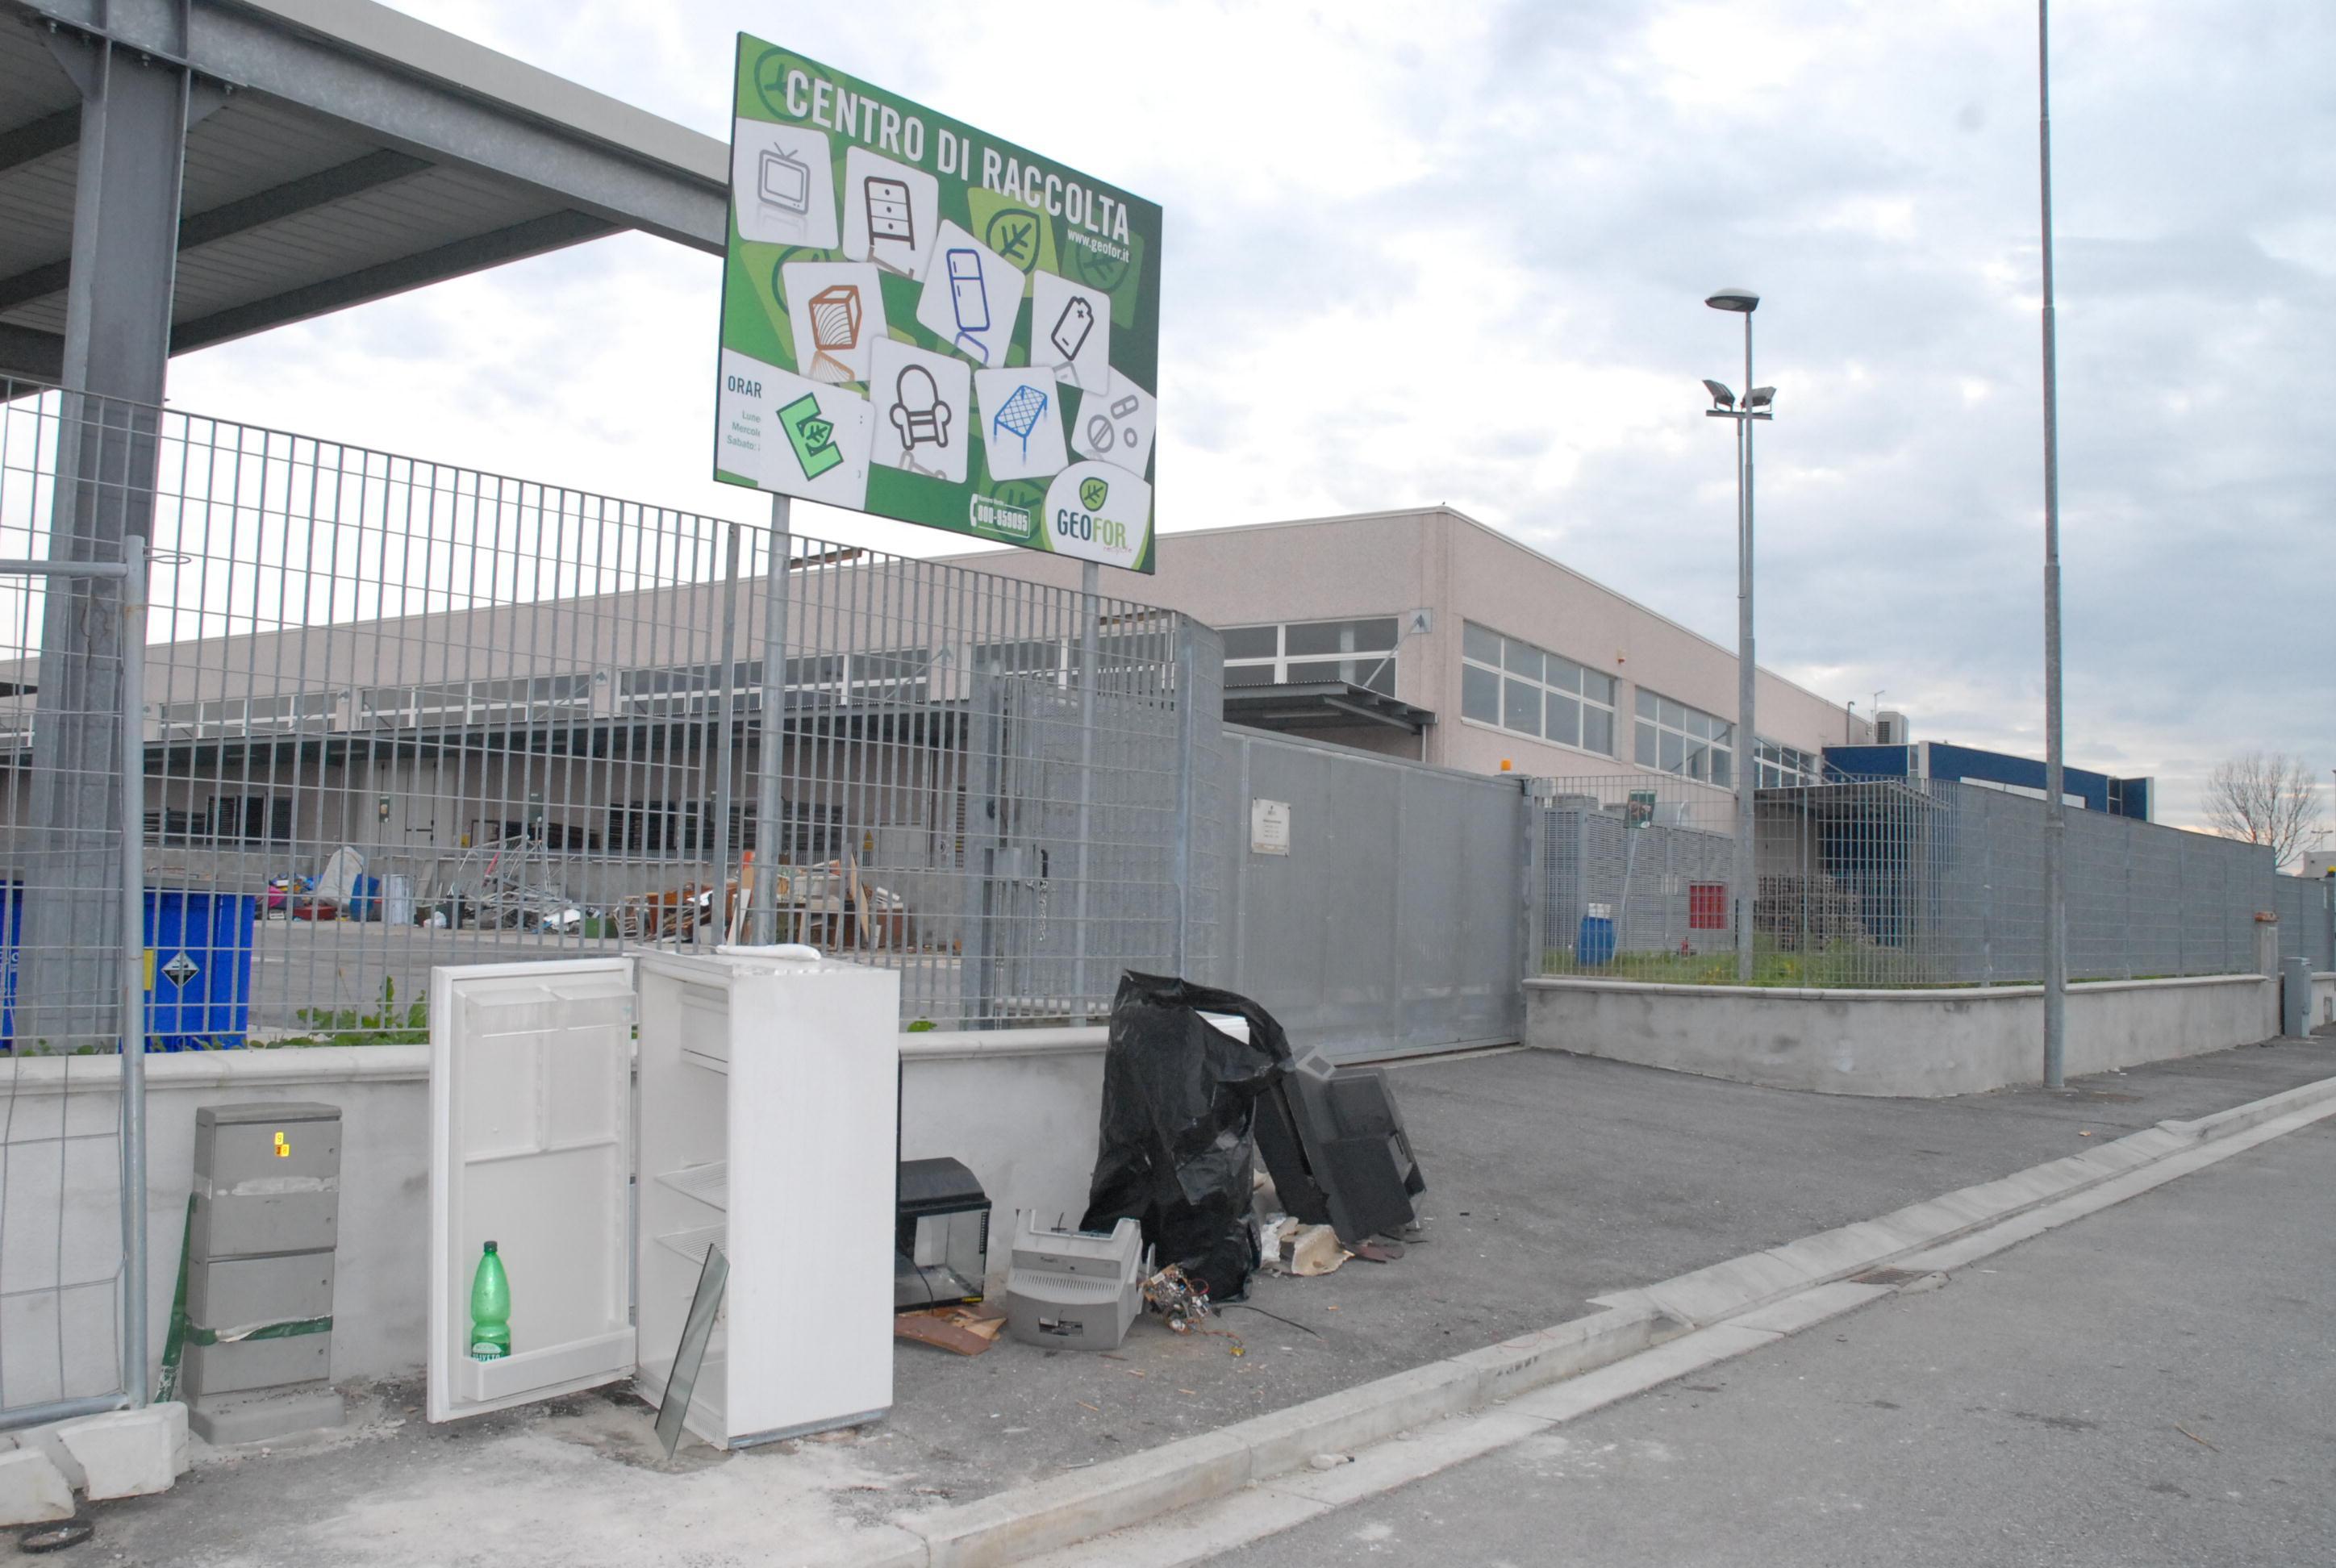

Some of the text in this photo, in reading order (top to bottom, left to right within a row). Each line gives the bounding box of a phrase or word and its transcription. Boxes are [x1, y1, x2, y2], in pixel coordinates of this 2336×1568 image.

[786, 69, 1129, 244] CENTRO DI RACCOLTA
[1067, 228, 1129, 264] www.geofor.it
[732, 422, 761, 436] Mercol
[1057, 508, 1126, 549] GEOFOR
